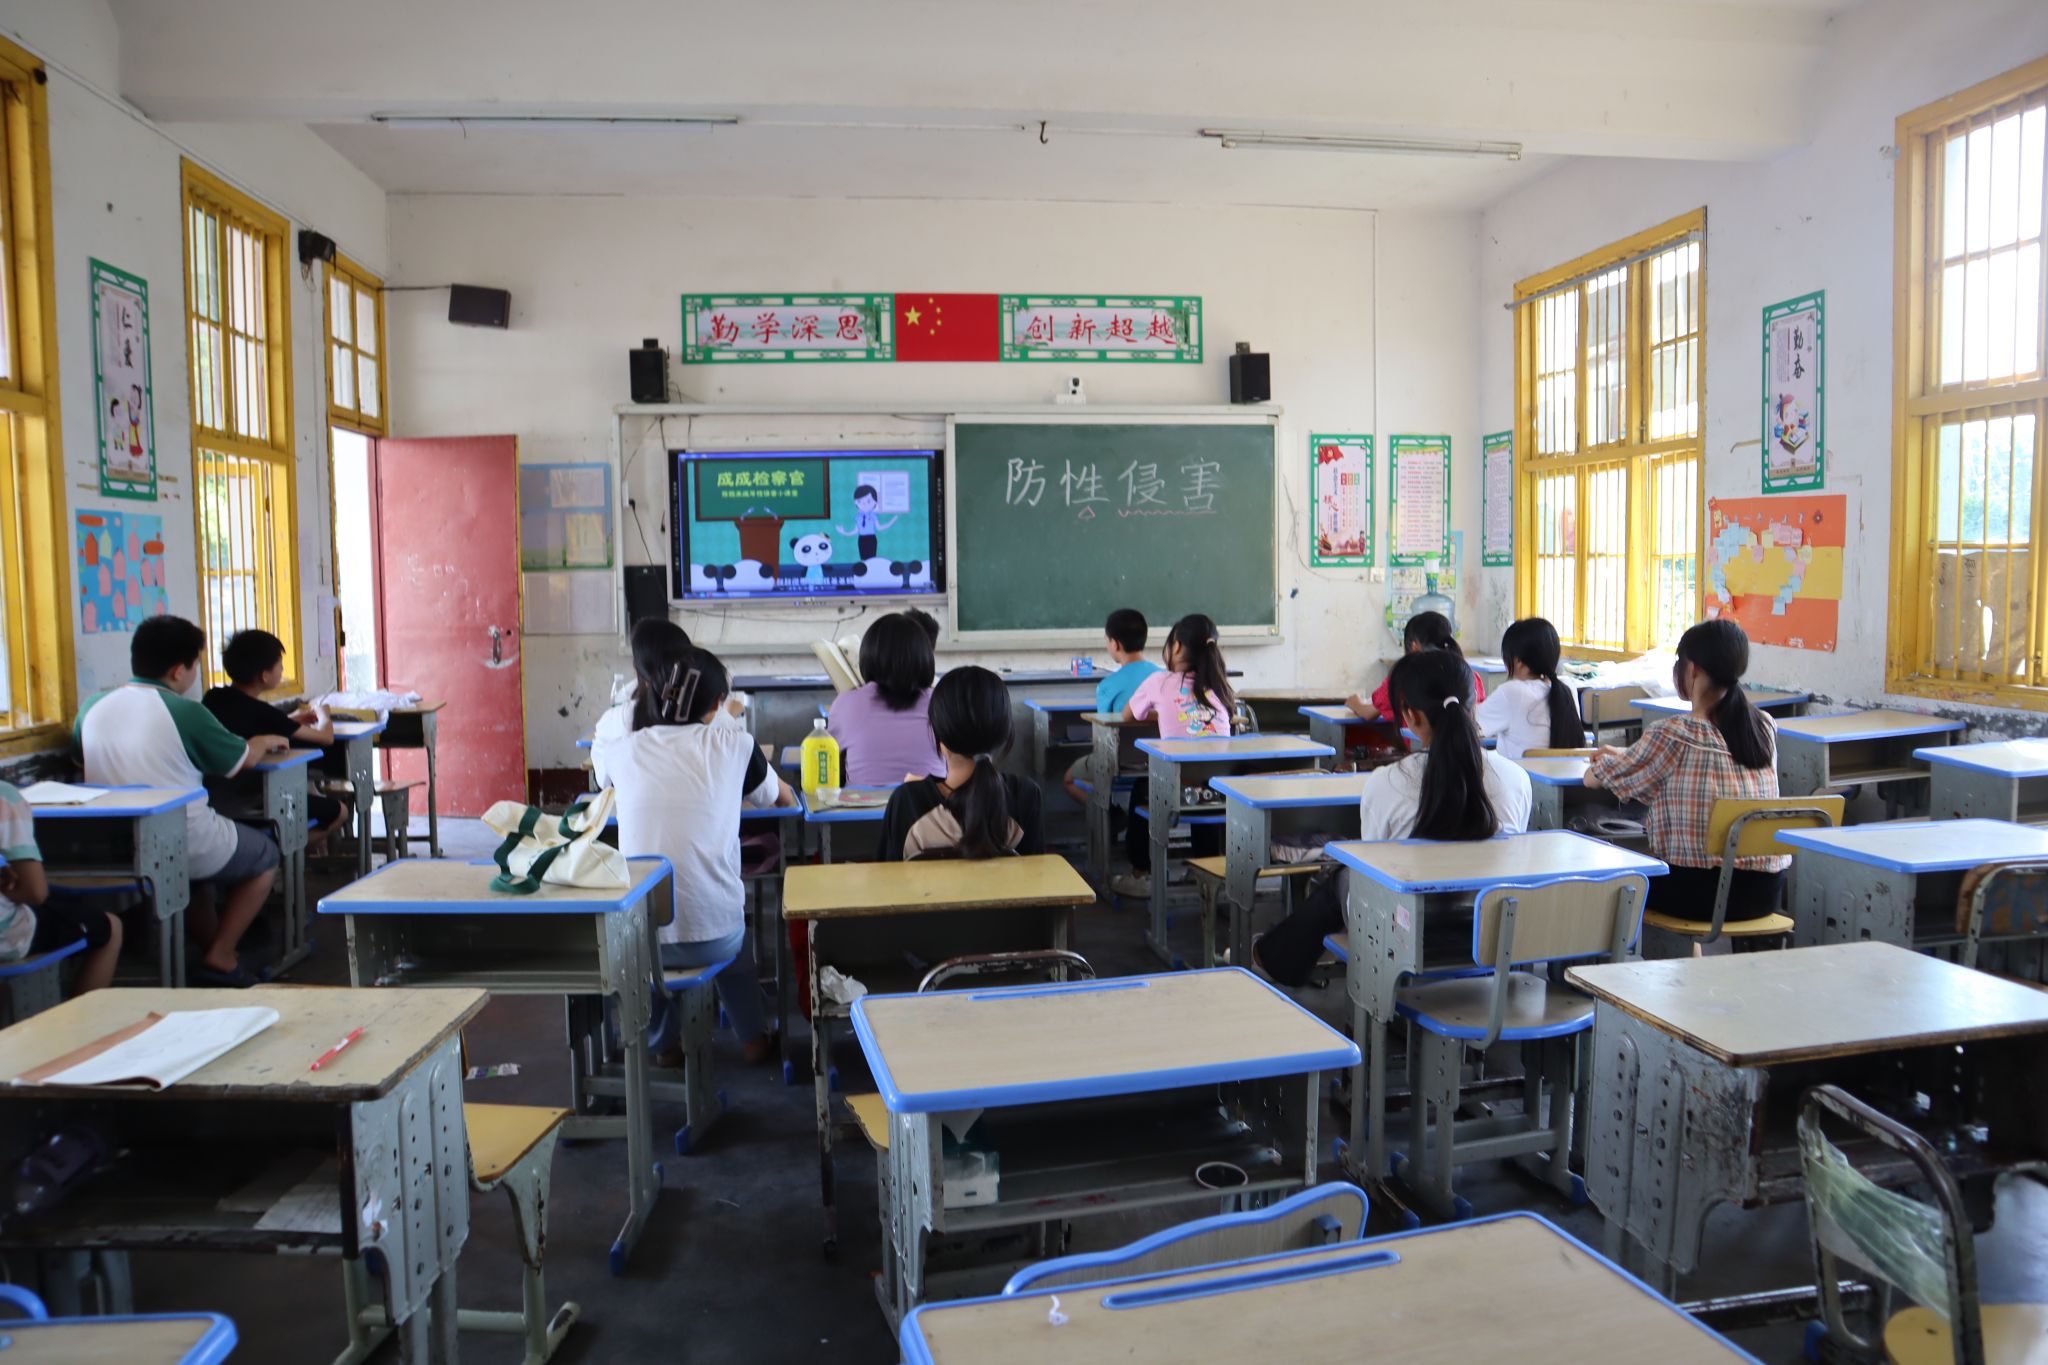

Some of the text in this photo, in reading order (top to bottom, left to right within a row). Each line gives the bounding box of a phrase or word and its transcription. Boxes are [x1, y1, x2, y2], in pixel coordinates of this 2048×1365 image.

[710, 312, 863, 344] 勤学深思
[1026, 313, 1177, 345] 创新超越
[1005, 457, 1220, 511] 防性侵害
